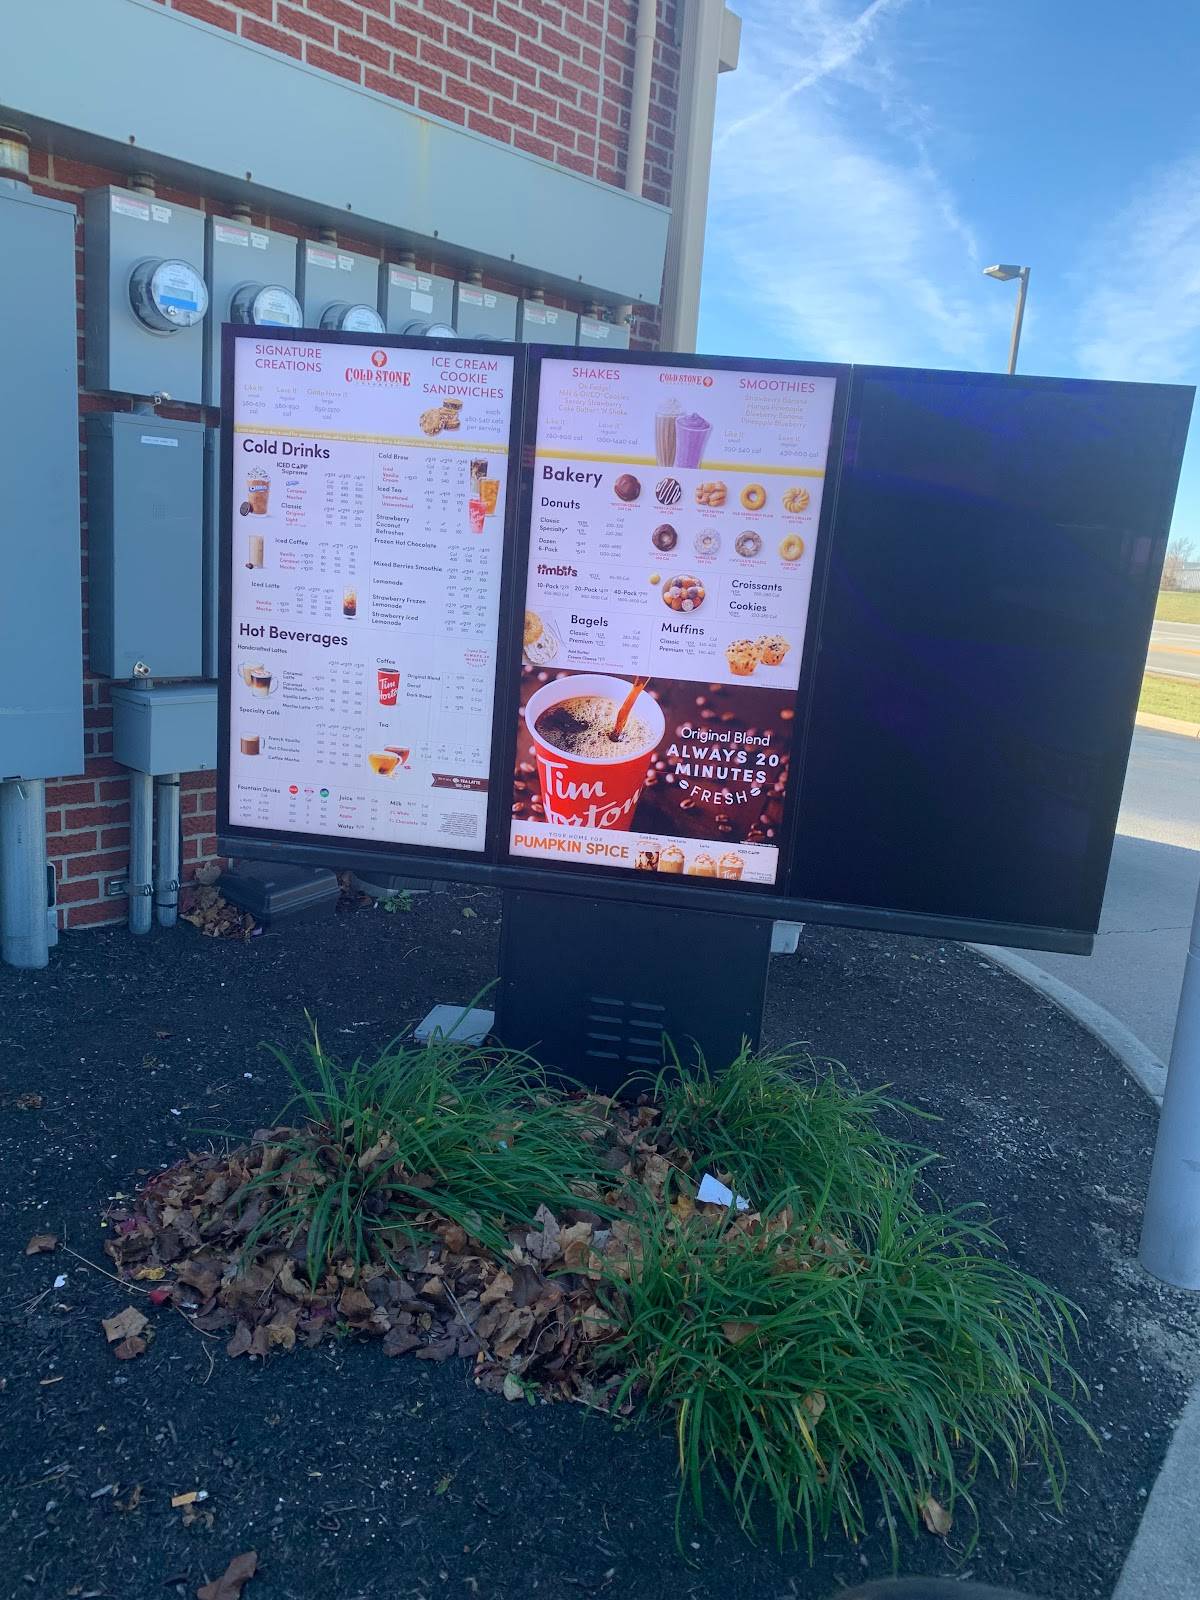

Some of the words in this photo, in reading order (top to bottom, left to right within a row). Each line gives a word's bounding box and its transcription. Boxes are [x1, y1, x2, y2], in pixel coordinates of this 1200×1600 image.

[255, 344, 322, 359] SIGNATURE
[255, 358, 322, 373] CREATIONS
[432, 356, 450, 368] ICE
[455, 358, 498, 371] CREAM
[345, 367, 373, 383] COLD
[375, 369, 411, 387] STONE
[440, 371, 487, 384] COOKIE
[572, 367, 620, 380] SHAKES
[659, 373, 678, 383] COLD
[678, 374, 702, 385] STONE
[423, 383, 504, 399] SANDWICHES
[739, 378, 816, 393] SMOOTHIES
[242, 438, 278, 455] Cold
[282, 441, 330, 459] Drinks
[378, 452, 392, 460] Cold
[393, 453, 409, 461] Brew
[276, 461, 290, 469] ICED
[281, 468, 308, 476] Supreme
[542, 465, 603, 488] Bakery
[541, 496, 581, 510] Donuts
[375, 514, 410, 523] Strawberry
[375, 521, 401, 529] Coconut
[375, 528, 404, 536] Refresher
[288, 538, 309, 546] Coffee
[374, 537, 394, 545] Frozen
[407, 540, 437, 549] Chocolate
[392, 561, 414, 569] Berries
[415, 563, 443, 572] Smoothie
[537, 563, 578, 577] timbits
[251, 580, 264, 588] Iced
[372, 578, 404, 586] Lemonade
[731, 579, 783, 592] Croissants
[372, 593, 406, 603] Strawberry
[372, 601, 403, 609] Lemonade
[729, 601, 767, 613] Cookies
[371, 611, 405, 620] Strawberry
[570, 614, 609, 628] Bagels
[371, 618, 402, 626] Lemonade
[240, 622, 266, 638] Hot
[269, 625, 349, 648] Beverages
[569, 629, 589, 637] Classic
[660, 622, 705, 636] Muffins
[568, 637, 594, 645] Premium
[659, 637, 680, 645] Classic
[271, 646, 288, 654] Lattes
[659, 645, 684, 653] Premium
[376, 657, 396, 665] Coffee
[239, 706, 265, 715] Specialty
[681, 726, 731, 743] Original
[734, 731, 771, 747] Blend
[667, 743, 748, 764] ALWAYS
[756, 753, 779, 767] 20
[536, 754, 607, 800] Tim
[675, 762, 767, 784] MINUTES
[263, 786, 281, 794] Drinks
[690, 786, 748, 805] FRESH
[514, 834, 581, 853] PUMPKIN
[586, 843, 630, 859] SPICE
